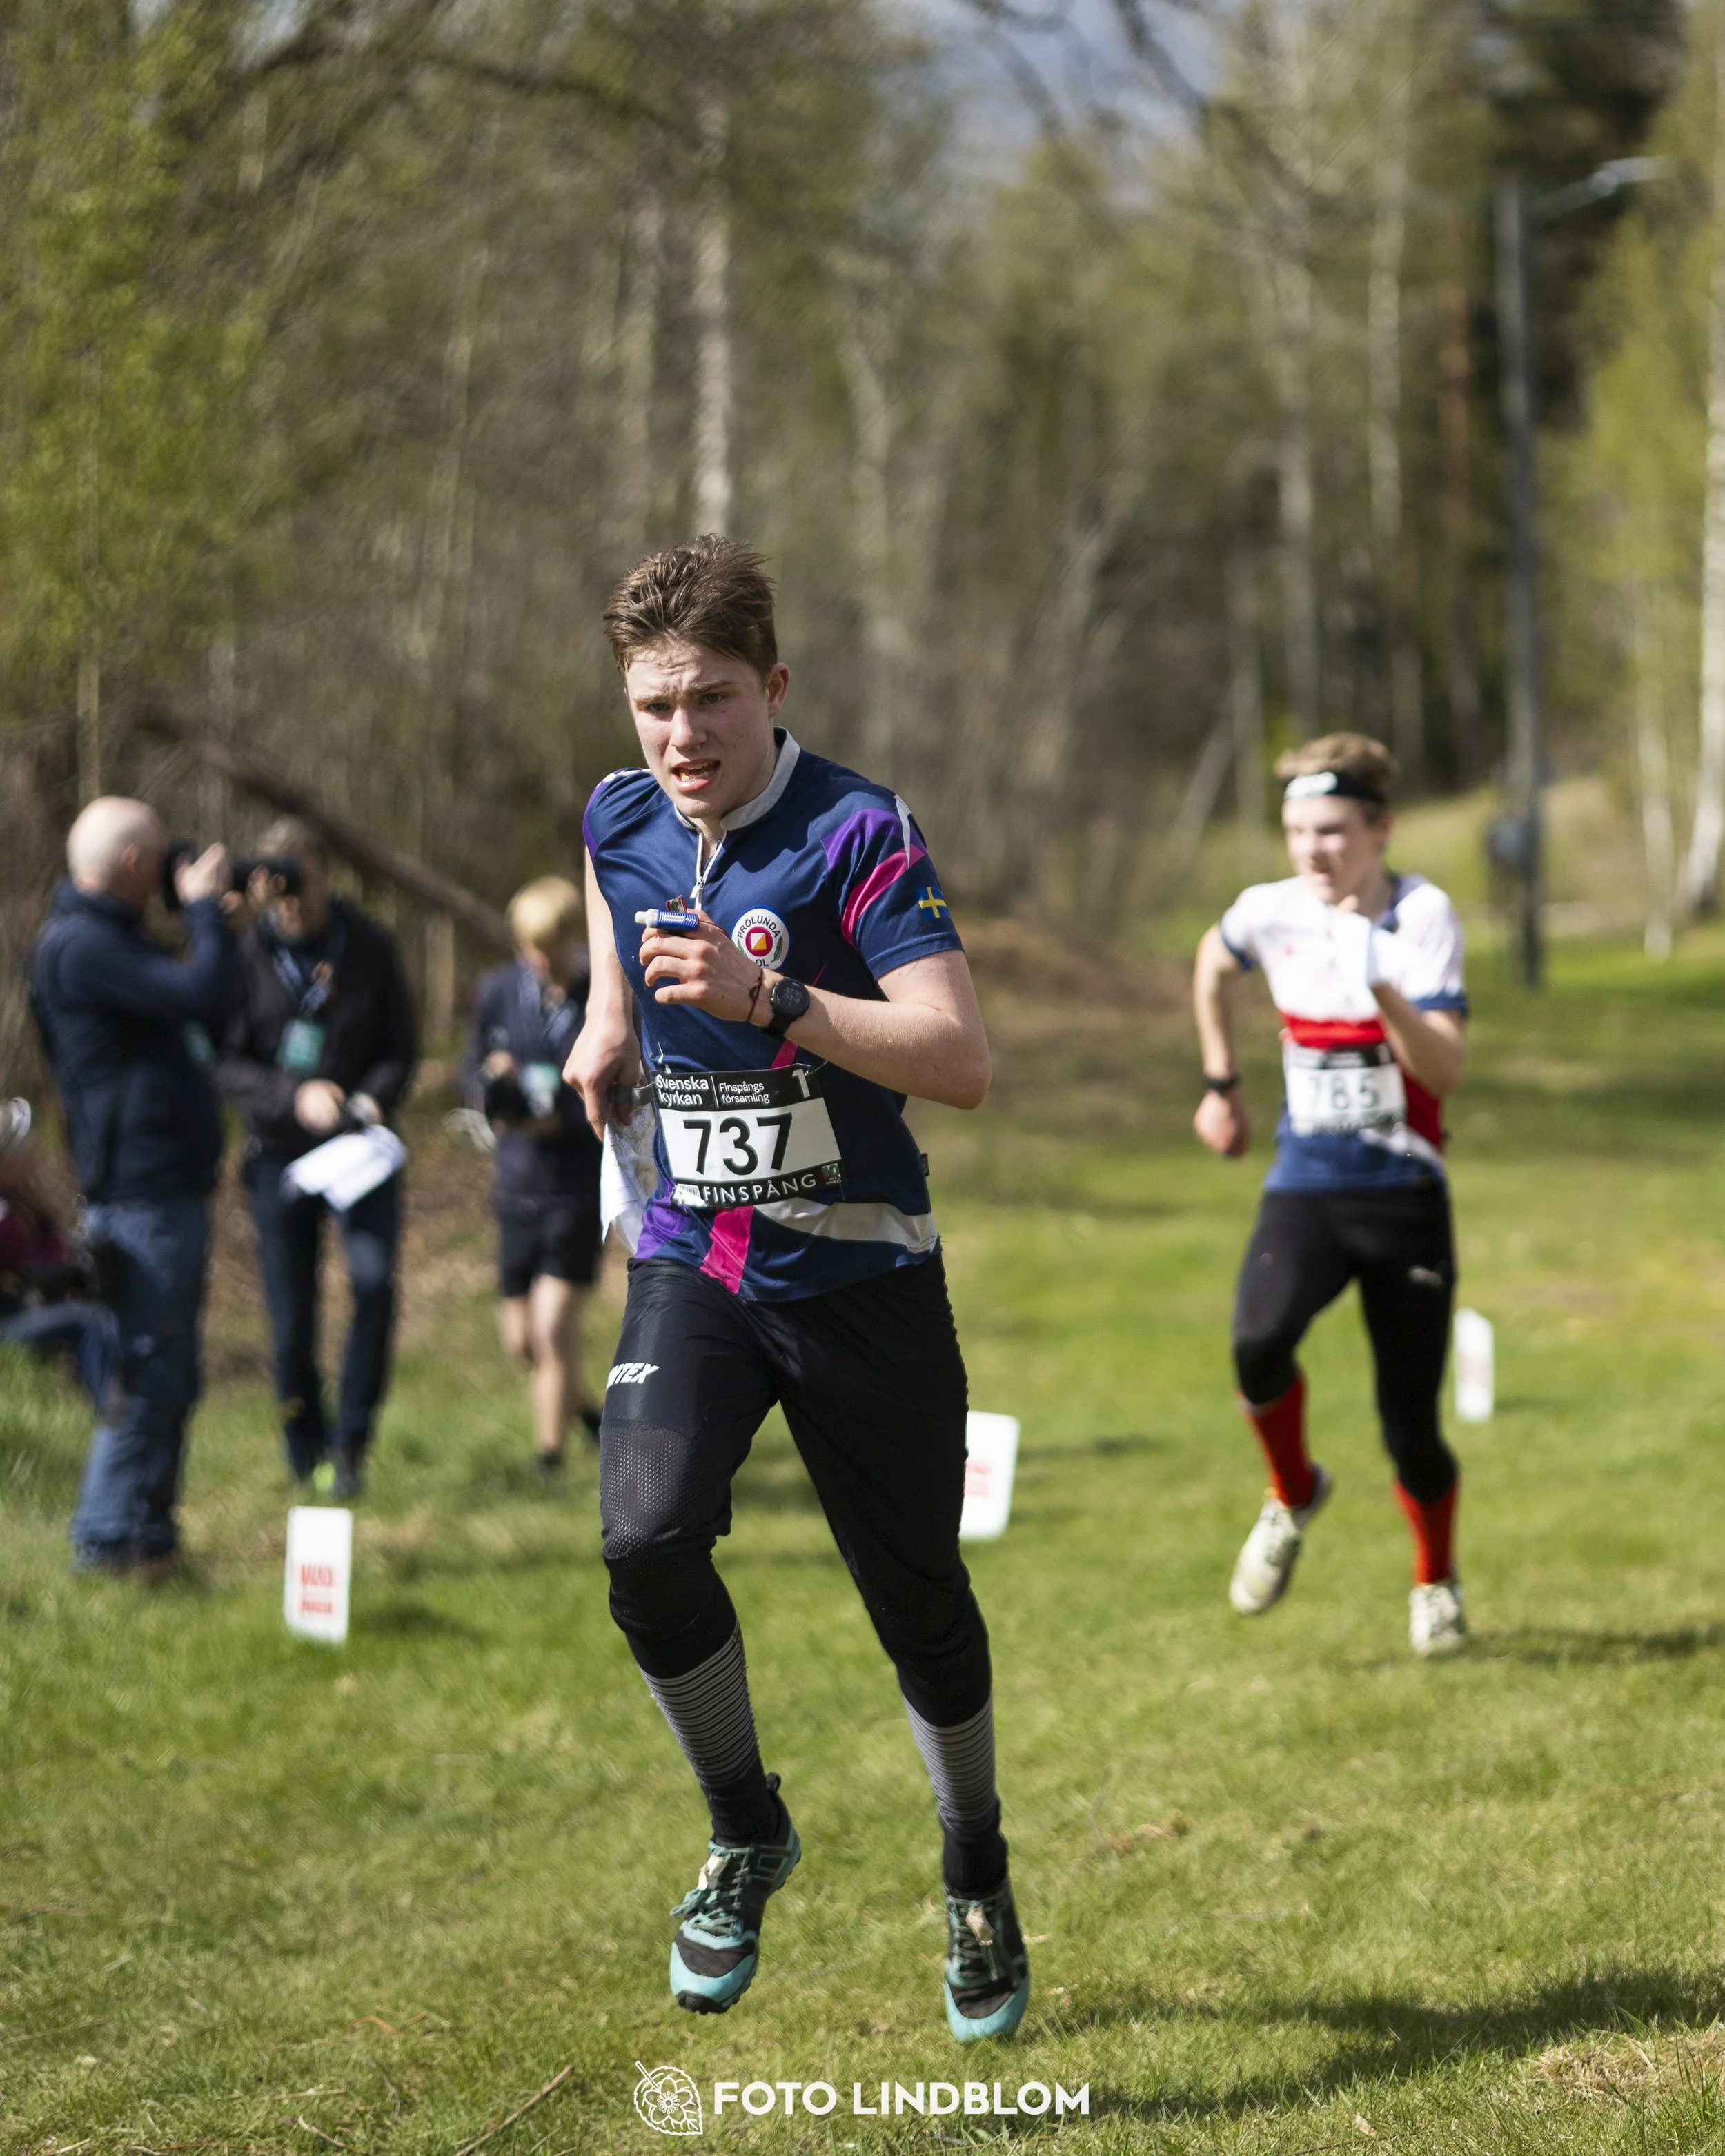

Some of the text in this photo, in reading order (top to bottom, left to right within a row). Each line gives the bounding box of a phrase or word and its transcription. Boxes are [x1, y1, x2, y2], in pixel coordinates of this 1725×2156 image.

[738, 915, 781, 938] FRÖLUNDA
[756, 958, 769, 967] OL
[656, 1074, 709, 1090] Svenska
[719, 1080, 765, 1094] Finspångs
[791, 1068, 811, 1098] 1
[658, 1088, 703, 1107] kyrkan
[721, 1092, 770, 1104] församling
[682, 1111, 793, 1176] 737
[702, 1174, 816, 1203] FINSPÅNG
